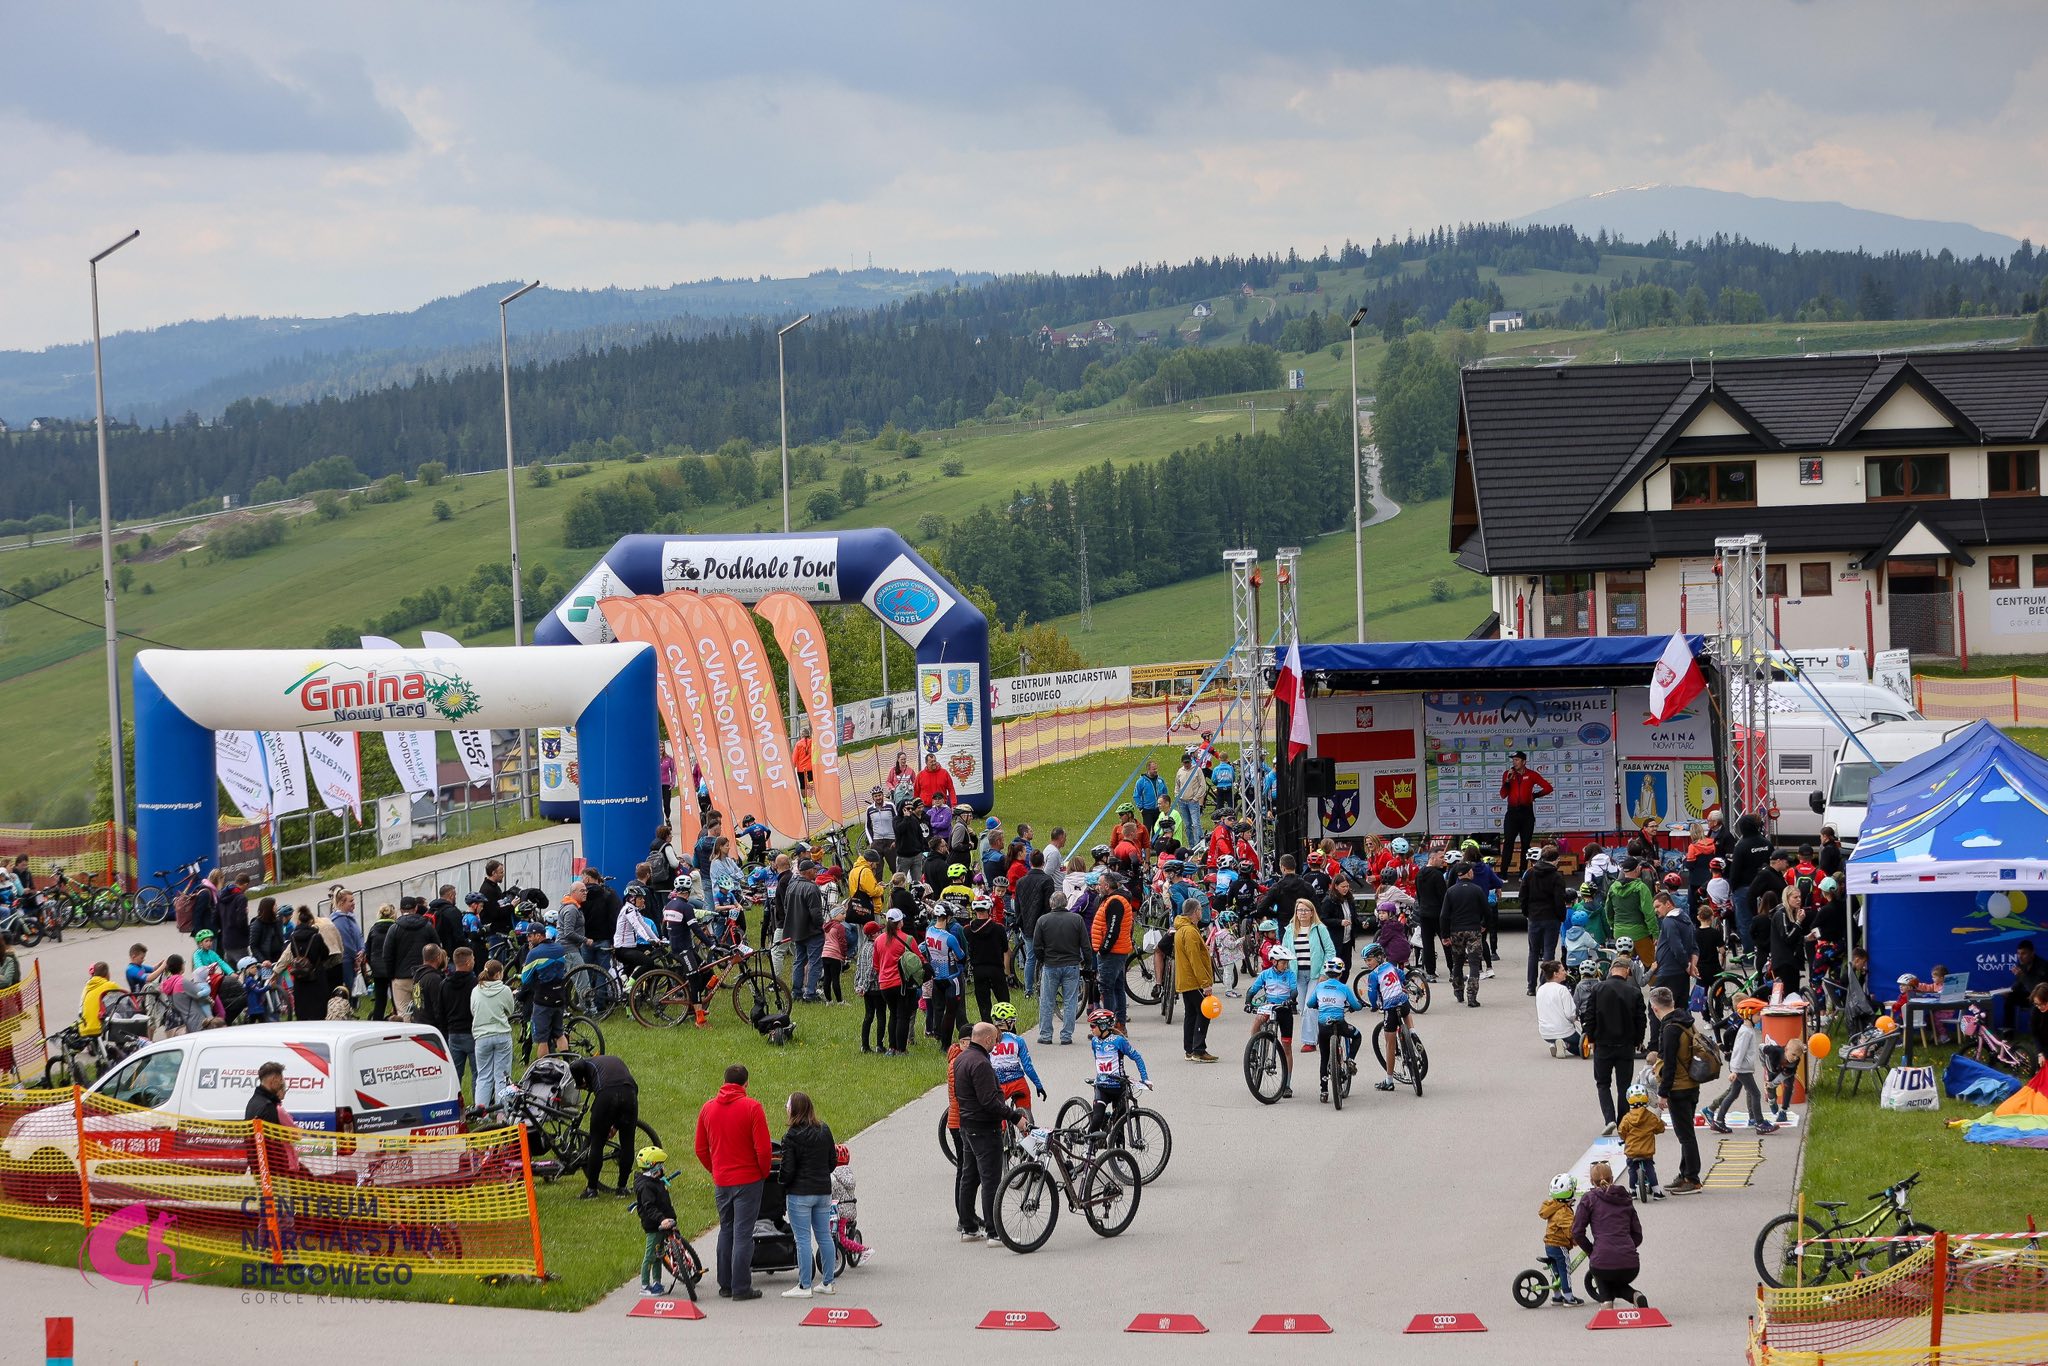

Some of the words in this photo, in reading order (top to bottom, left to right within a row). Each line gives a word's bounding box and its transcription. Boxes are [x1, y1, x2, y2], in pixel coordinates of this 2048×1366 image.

[703, 556, 788, 580] Podhale
[793, 555, 836, 579] Tour
[1996, 596, 2046, 606] CENTRUM
[1011, 677, 1051, 690] CENTRUM
[1055, 670, 1117, 685] NARCIARSTWA
[301, 671, 427, 712] Gmina
[1011, 689, 1061, 704] BIEGOWEGO
[334, 706, 383, 722] Nowy
[385, 701, 427, 719] Targ
[1543, 700, 1607, 711] PODHALE
[1453, 709, 1498, 726] Mini
[1546, 712, 1582, 722] TOUR
[1651, 732, 1695, 741] GMINA
[1643, 762, 1669, 770] WYŻNA
[582, 795, 648, 806] www.ugnowytarg.pl
[926, 937, 942, 951] 3M
[1976, 953, 2018, 962] GMIN
[992, 1043, 1015, 1056] 3M
[220, 1077, 324, 1090] TRACTECH
[1906, 1098, 1933, 1107] ACTION
[294, 1121, 325, 1129] ERVICE
